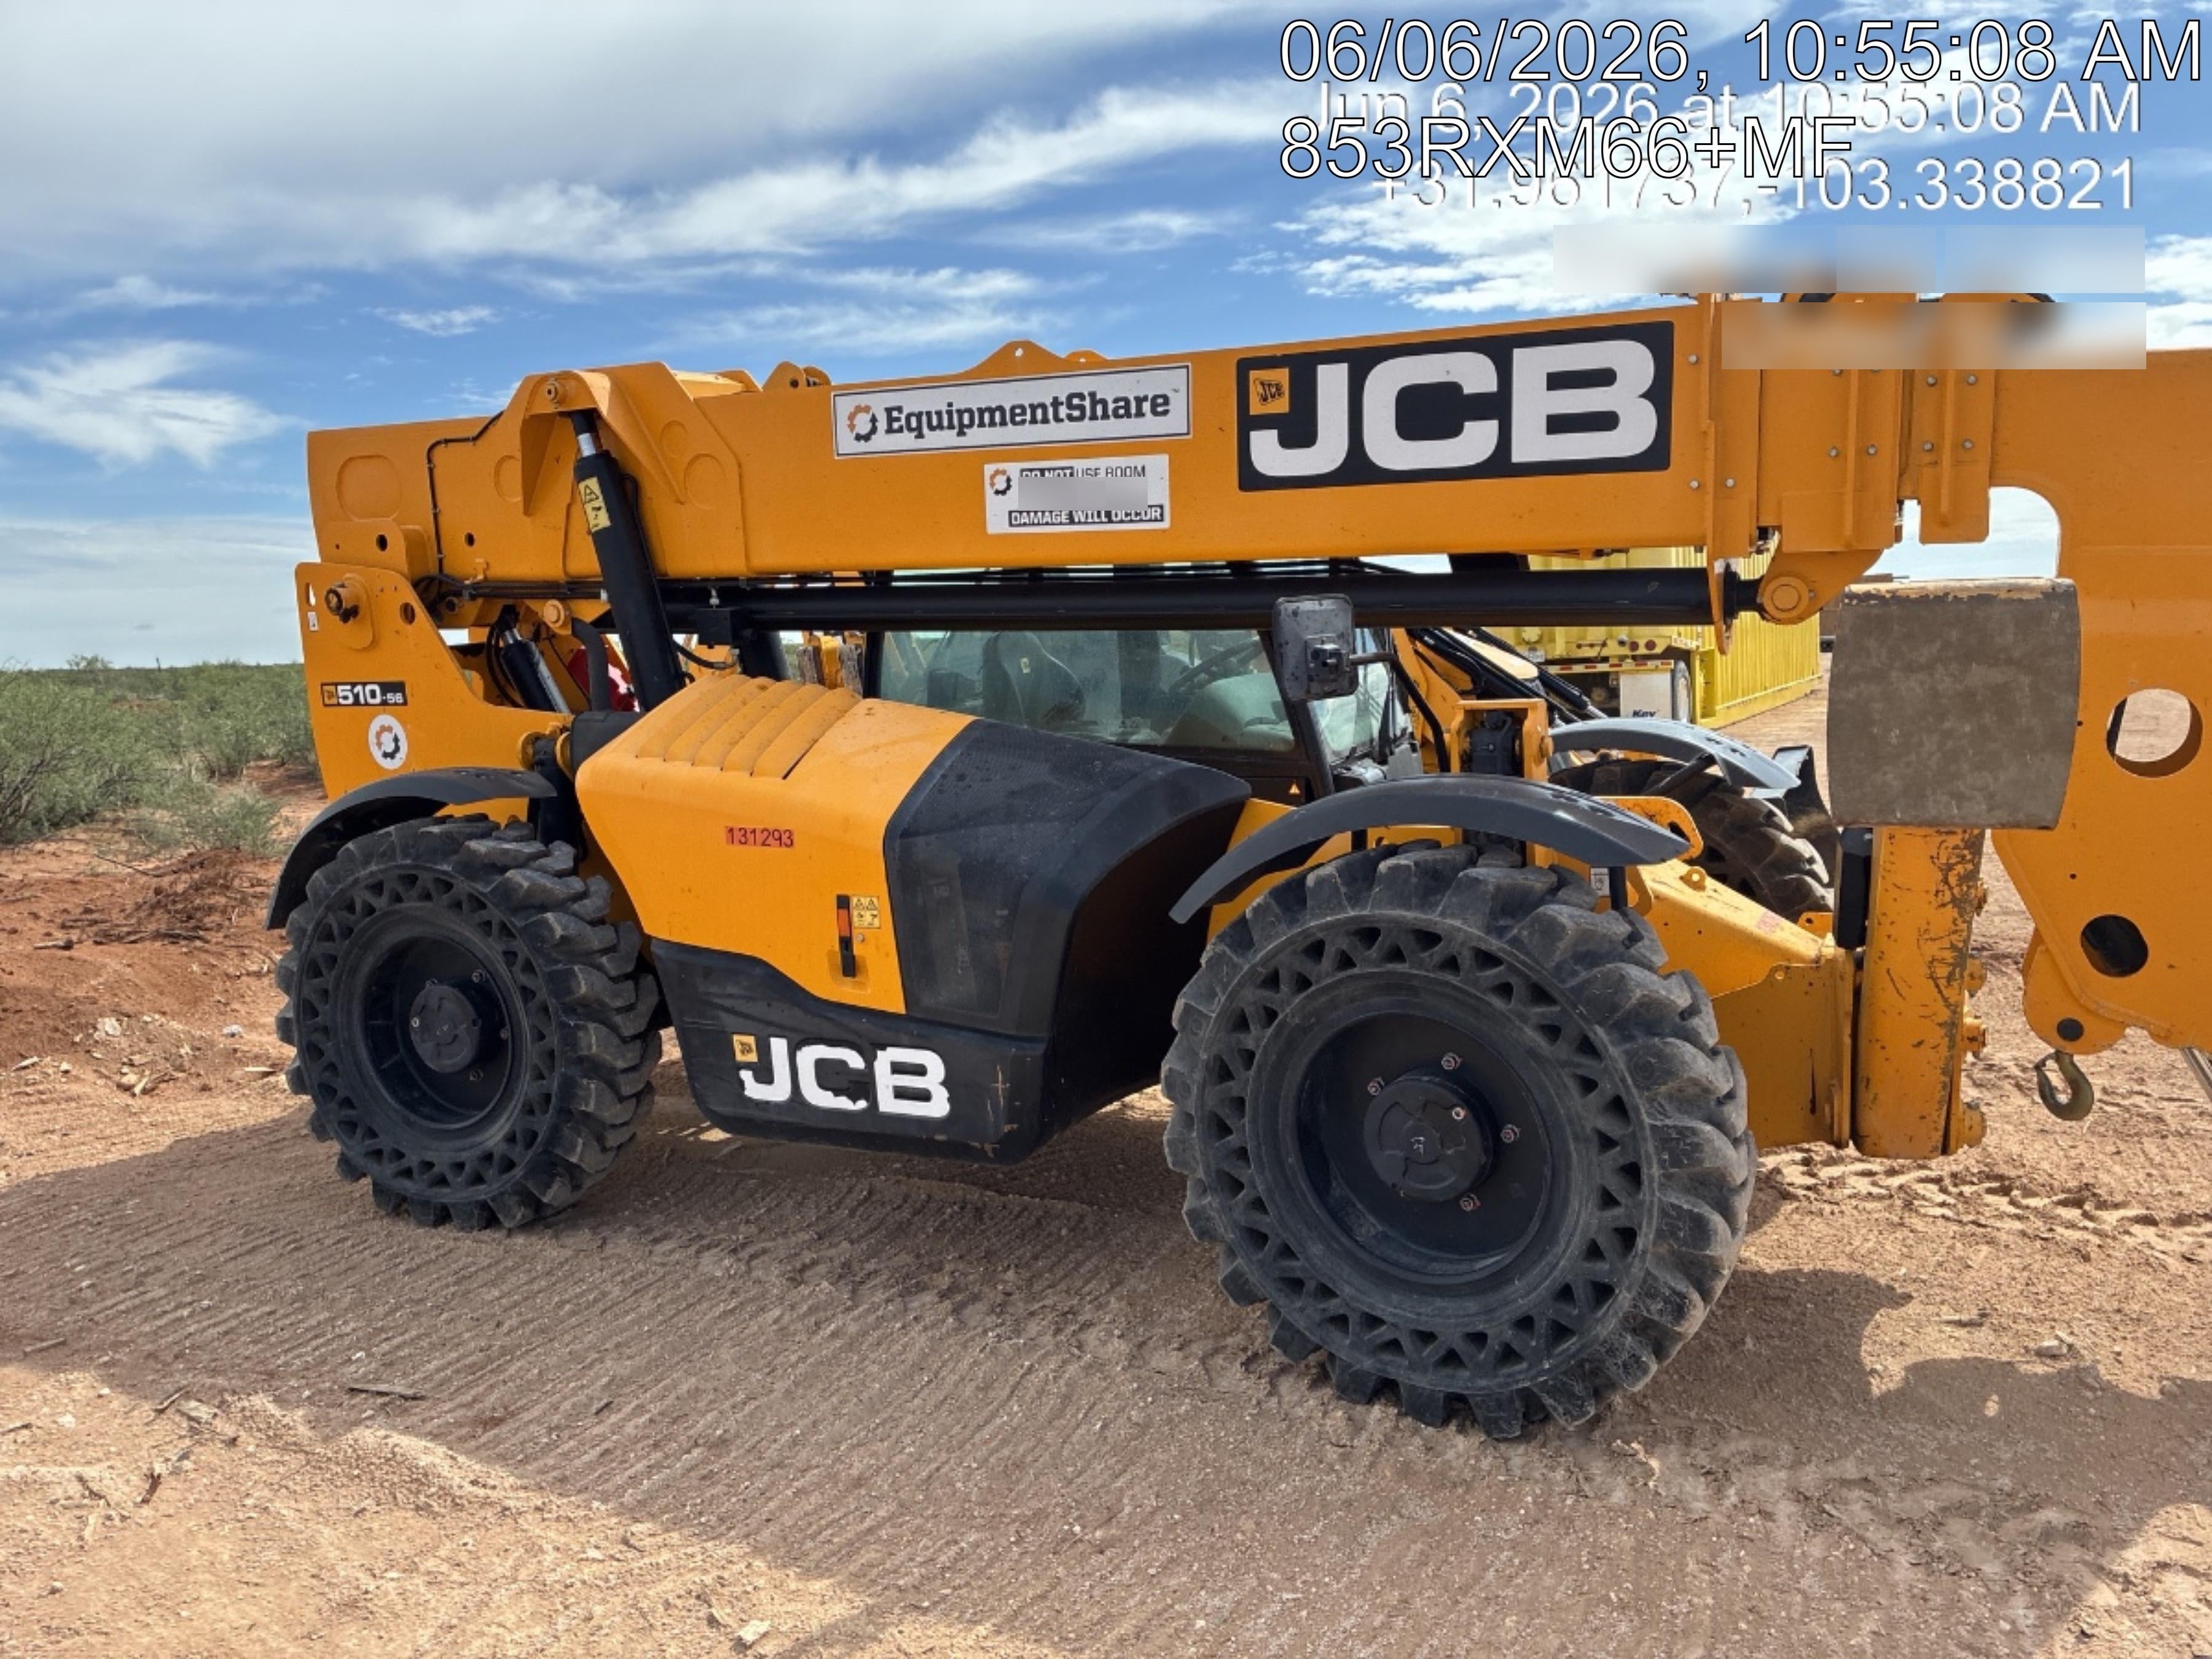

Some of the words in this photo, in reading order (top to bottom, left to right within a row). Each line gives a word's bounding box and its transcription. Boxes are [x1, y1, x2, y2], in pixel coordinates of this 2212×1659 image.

[884, 391, 1171, 439] EquipmentShare
[1249, 338, 1658, 477] JCB
[1011, 511, 1070, 525] DAMAGE
[1072, 510, 1109, 523] WILL
[1110, 507, 1162, 522] OCCUR
[728, 827, 794, 849] 131293
[739, 1037, 951, 1118] JCB
